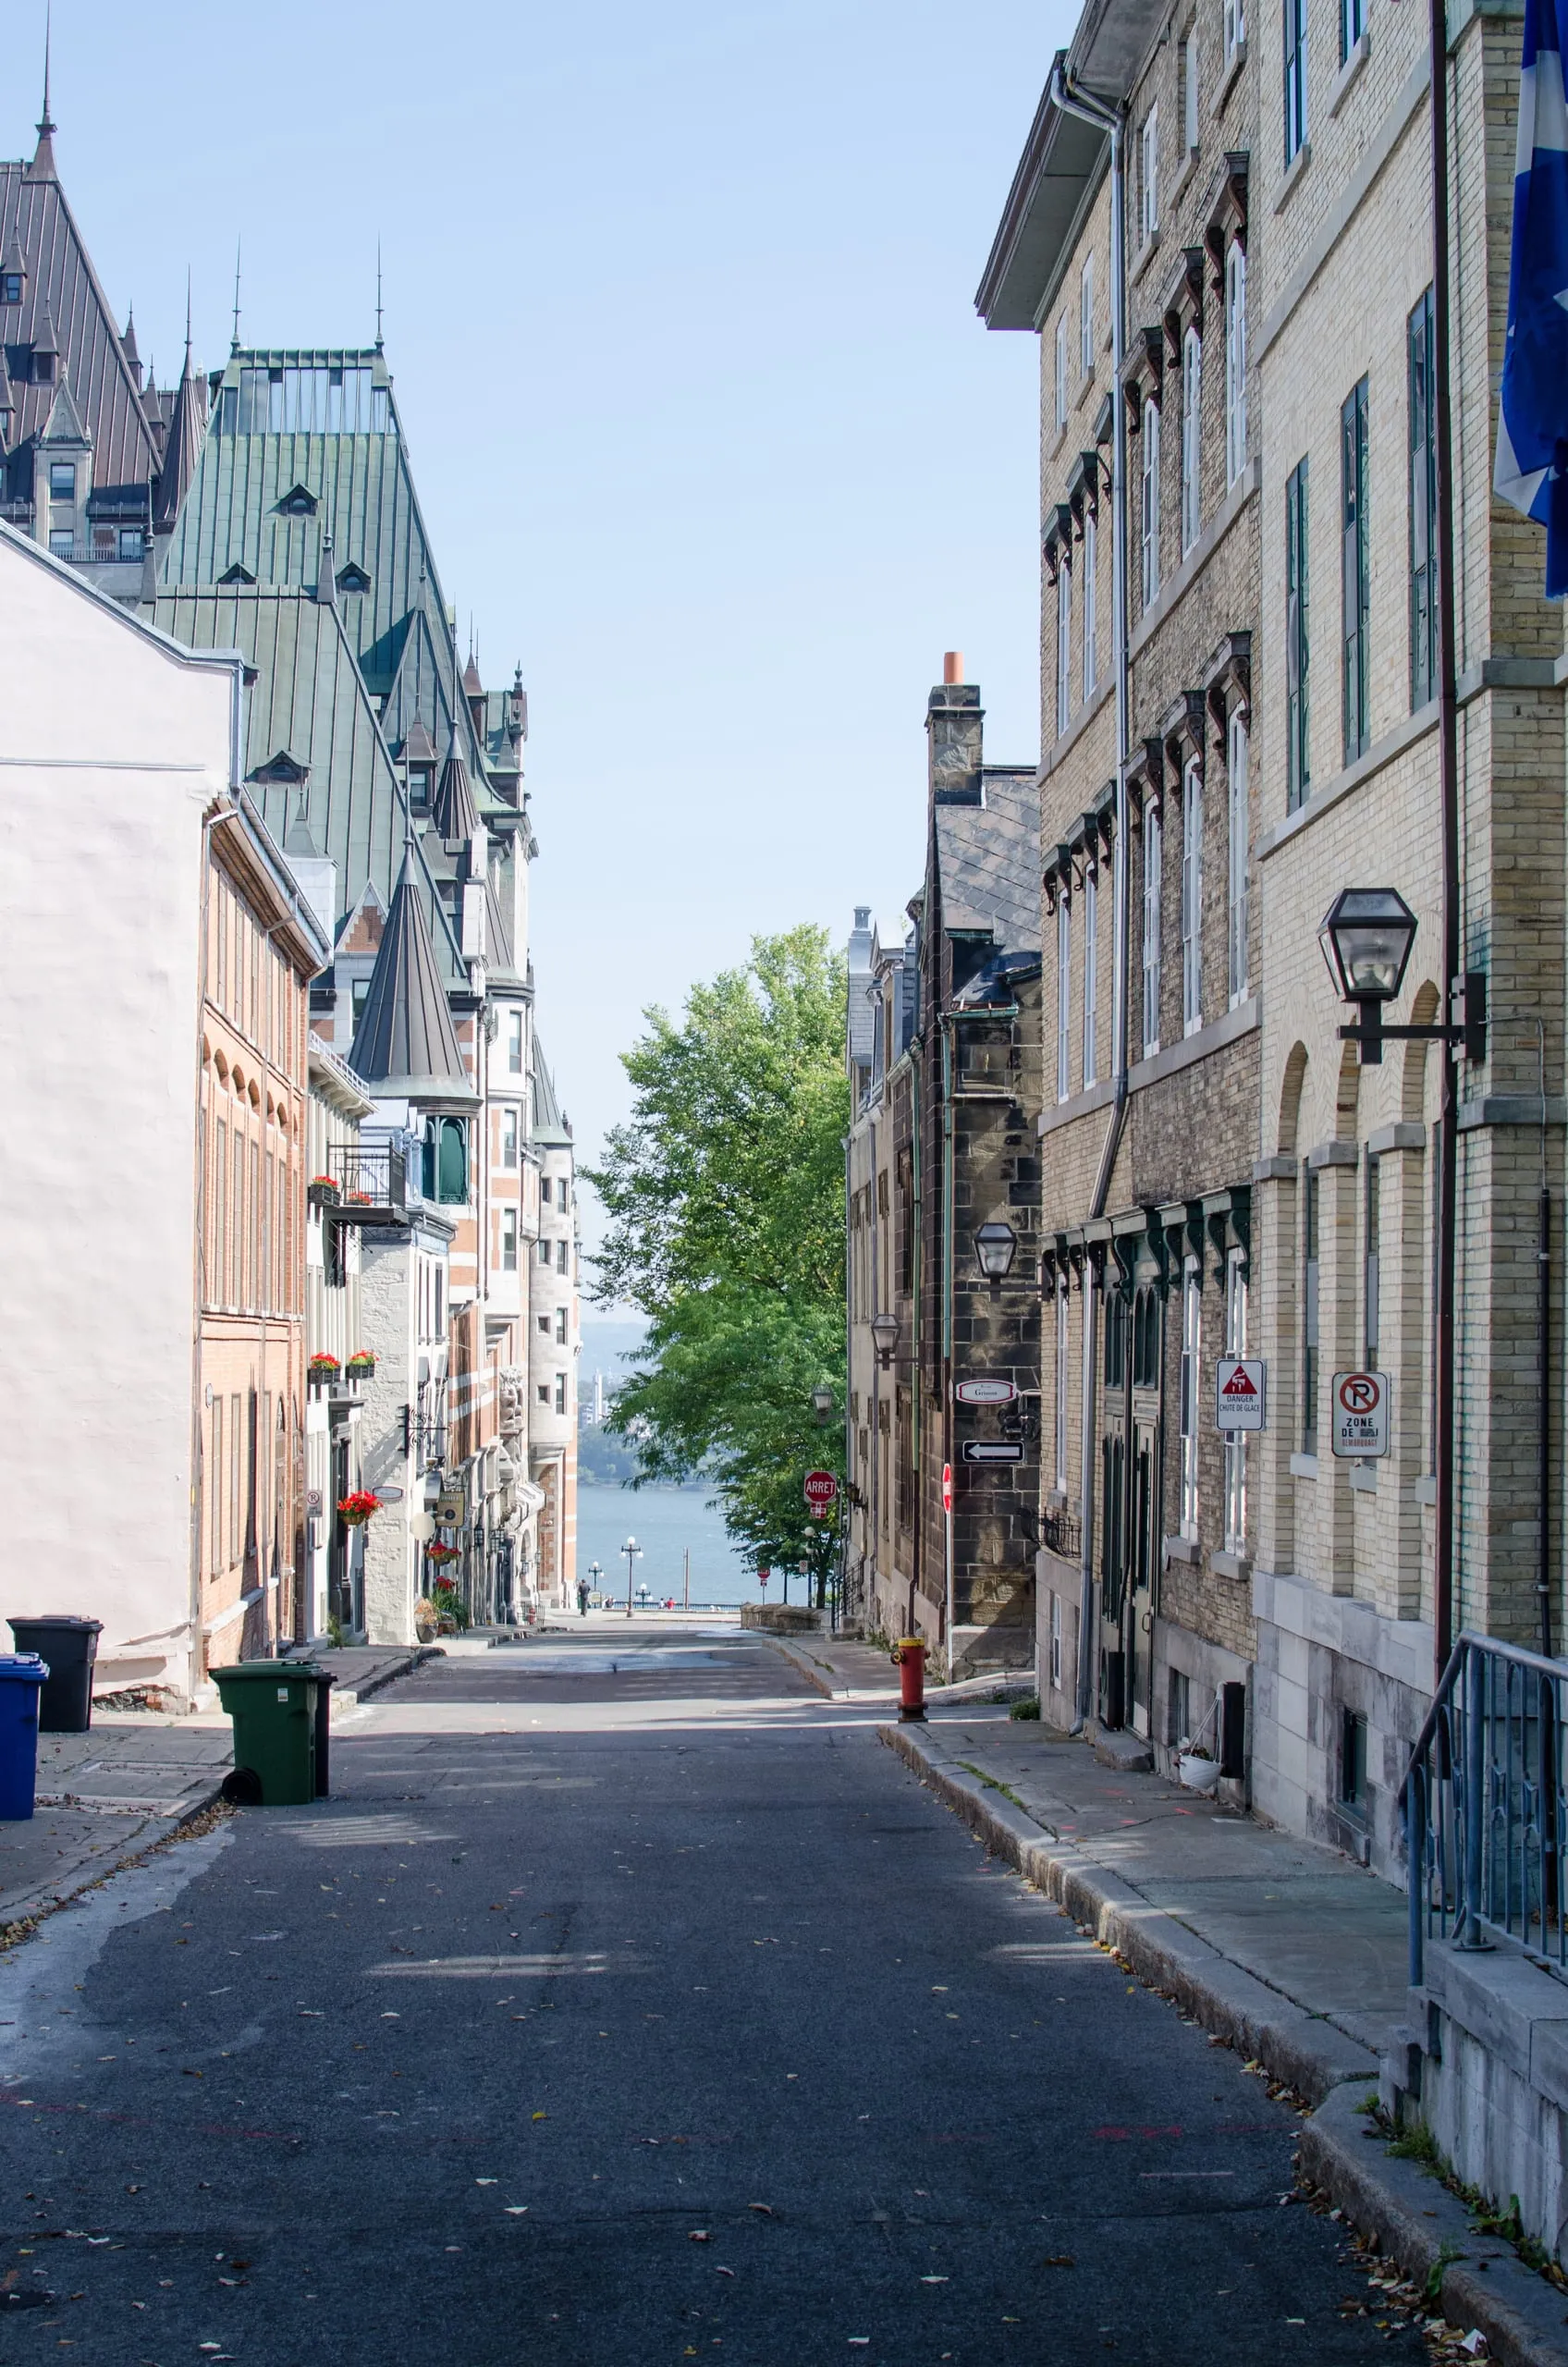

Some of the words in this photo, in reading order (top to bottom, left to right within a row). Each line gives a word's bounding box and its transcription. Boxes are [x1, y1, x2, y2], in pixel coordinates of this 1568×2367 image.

[1226, 1394, 1254, 1403] DANGER
[1219, 1404, 1235, 1412] CHUTE
[1236, 1404, 1243, 1412] DE
[1244, 1404, 1260, 1412] GLACE
[1346, 1417, 1374, 1427] ZONE
[1341, 1428, 1354, 1438] DE
[805, 1480, 835, 1494] ARRET
